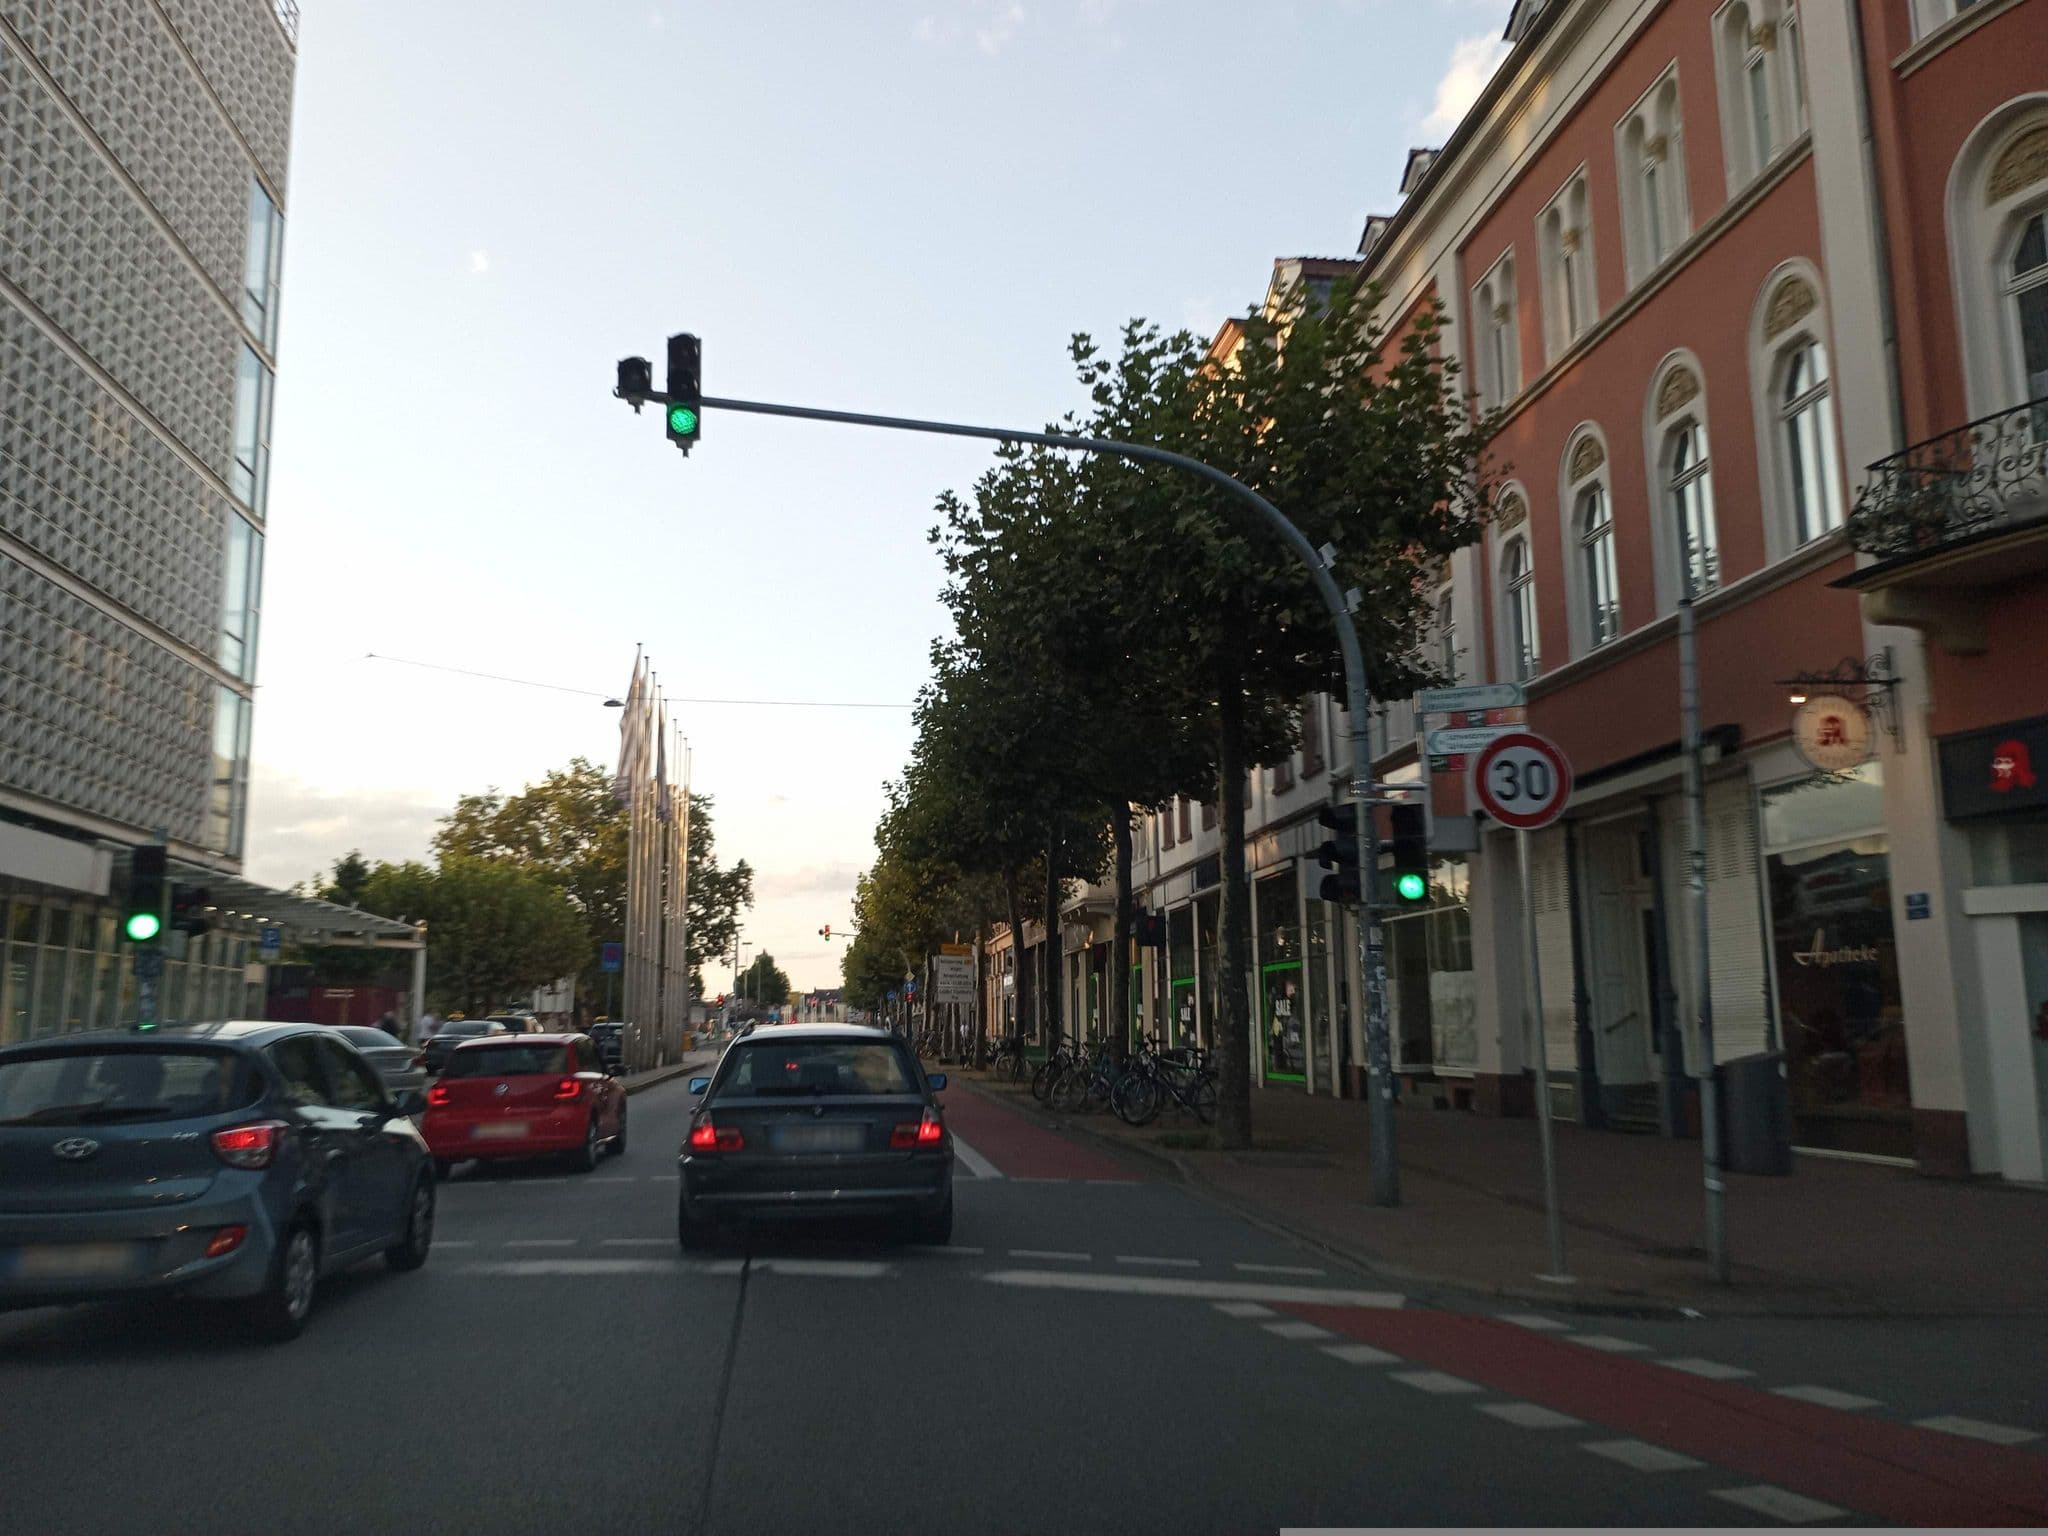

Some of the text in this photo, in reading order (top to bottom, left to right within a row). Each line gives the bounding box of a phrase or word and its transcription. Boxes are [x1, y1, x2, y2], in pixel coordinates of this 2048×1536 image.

[1495, 760, 1550, 800] 30
[1792, 928, 1879, 967] Apotheke
[1275, 999, 1291, 1016] SALE
